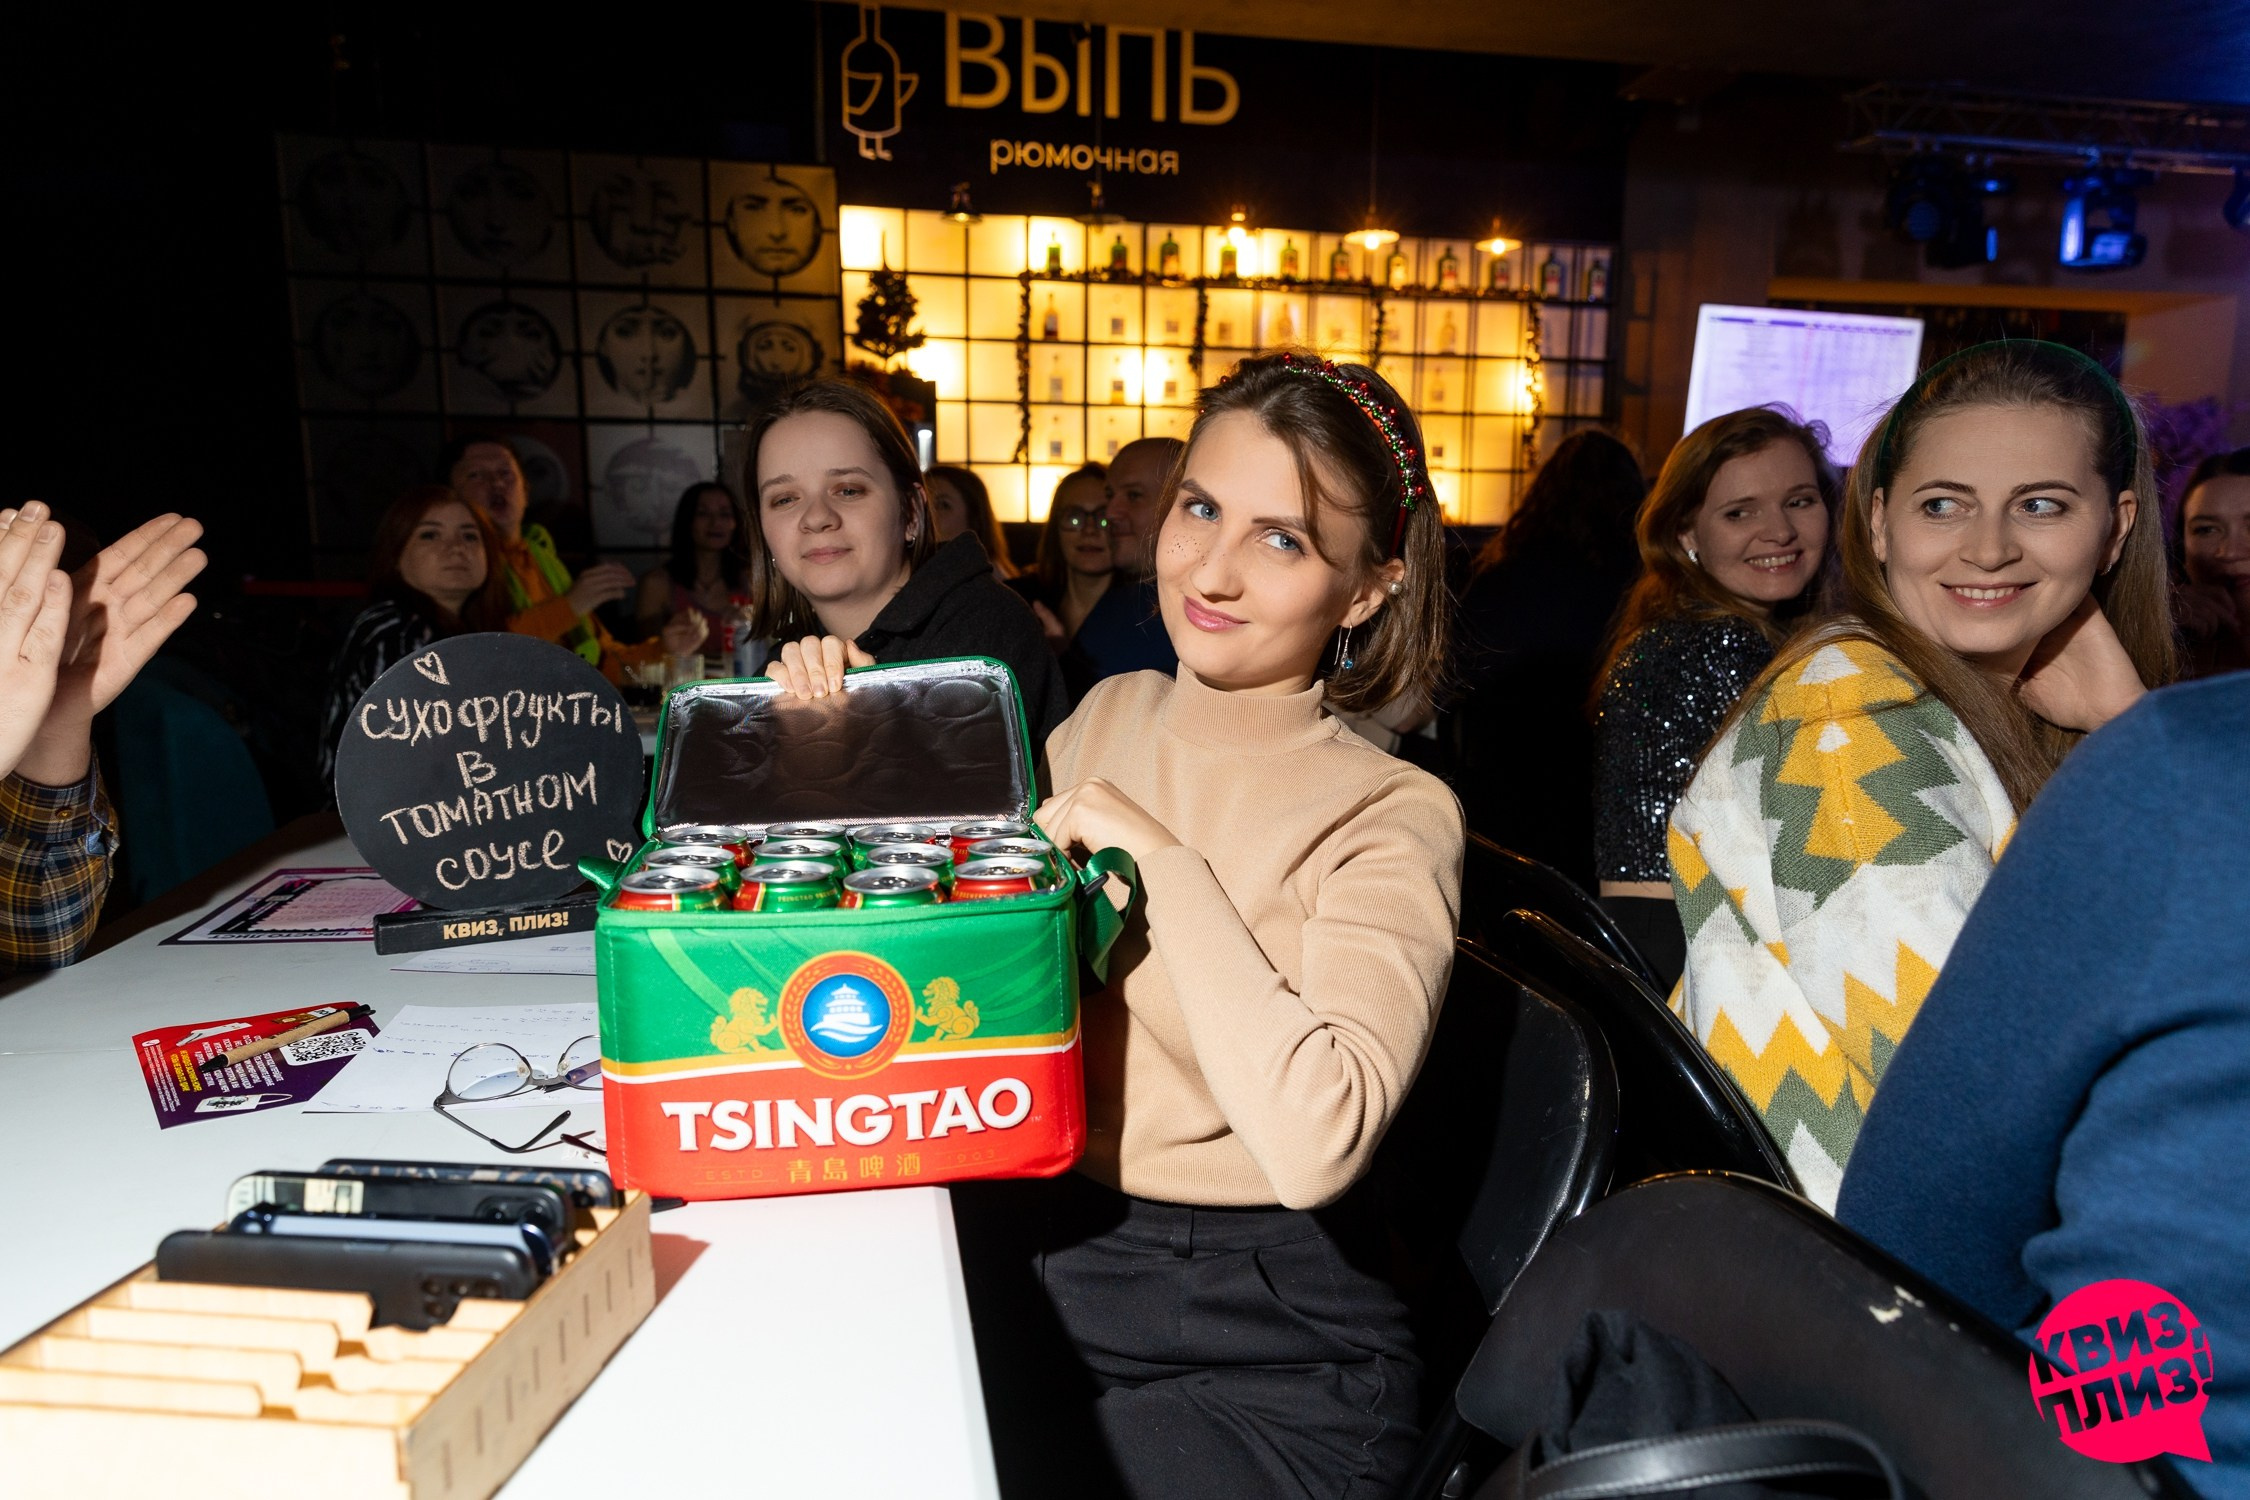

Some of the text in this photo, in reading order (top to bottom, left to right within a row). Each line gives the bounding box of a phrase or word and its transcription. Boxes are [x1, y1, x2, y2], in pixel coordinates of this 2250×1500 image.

[945, 11, 1240, 125] ВЫПЬ
[989, 140, 1180, 175] рюмочная
[379, 762, 598, 845] ТОМАТНОМ
[509, 911, 569, 932] ПЛИЗ!
[661, 1077, 1032, 1151] TSINGTAO
[786, 1152, 922, 1185] 青島啤酒
